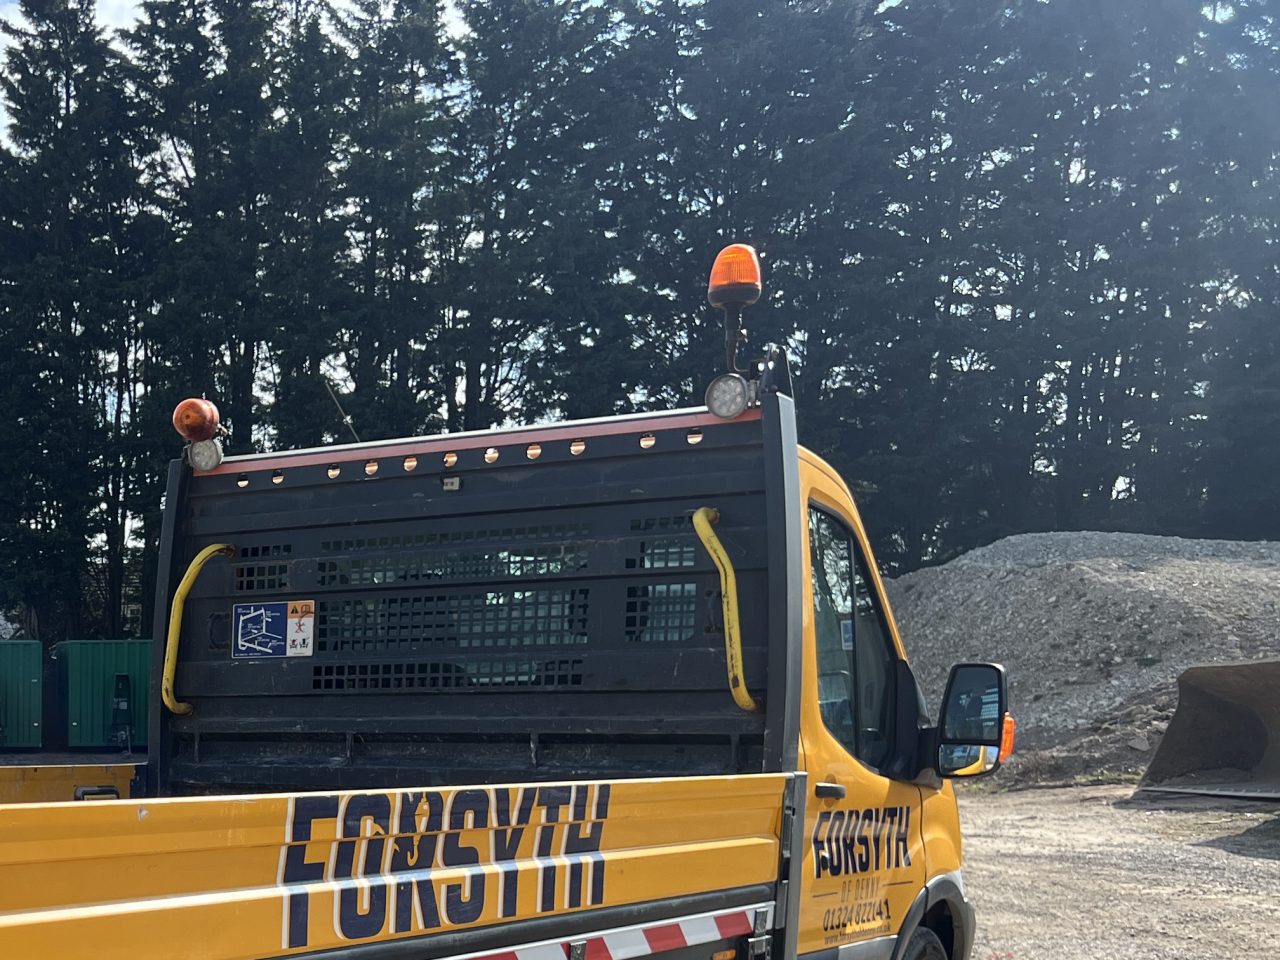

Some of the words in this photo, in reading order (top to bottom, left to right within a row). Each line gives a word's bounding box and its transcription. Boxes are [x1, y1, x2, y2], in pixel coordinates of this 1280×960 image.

[276, 783, 611, 949] FORSYTH
[812, 806, 912, 879] FORSYTH
[823, 904, 855, 932] 01324
[854, 898, 891, 925] 822141
[840, 881, 853, 903] OF
[855, 876, 881, 901] DENNY
